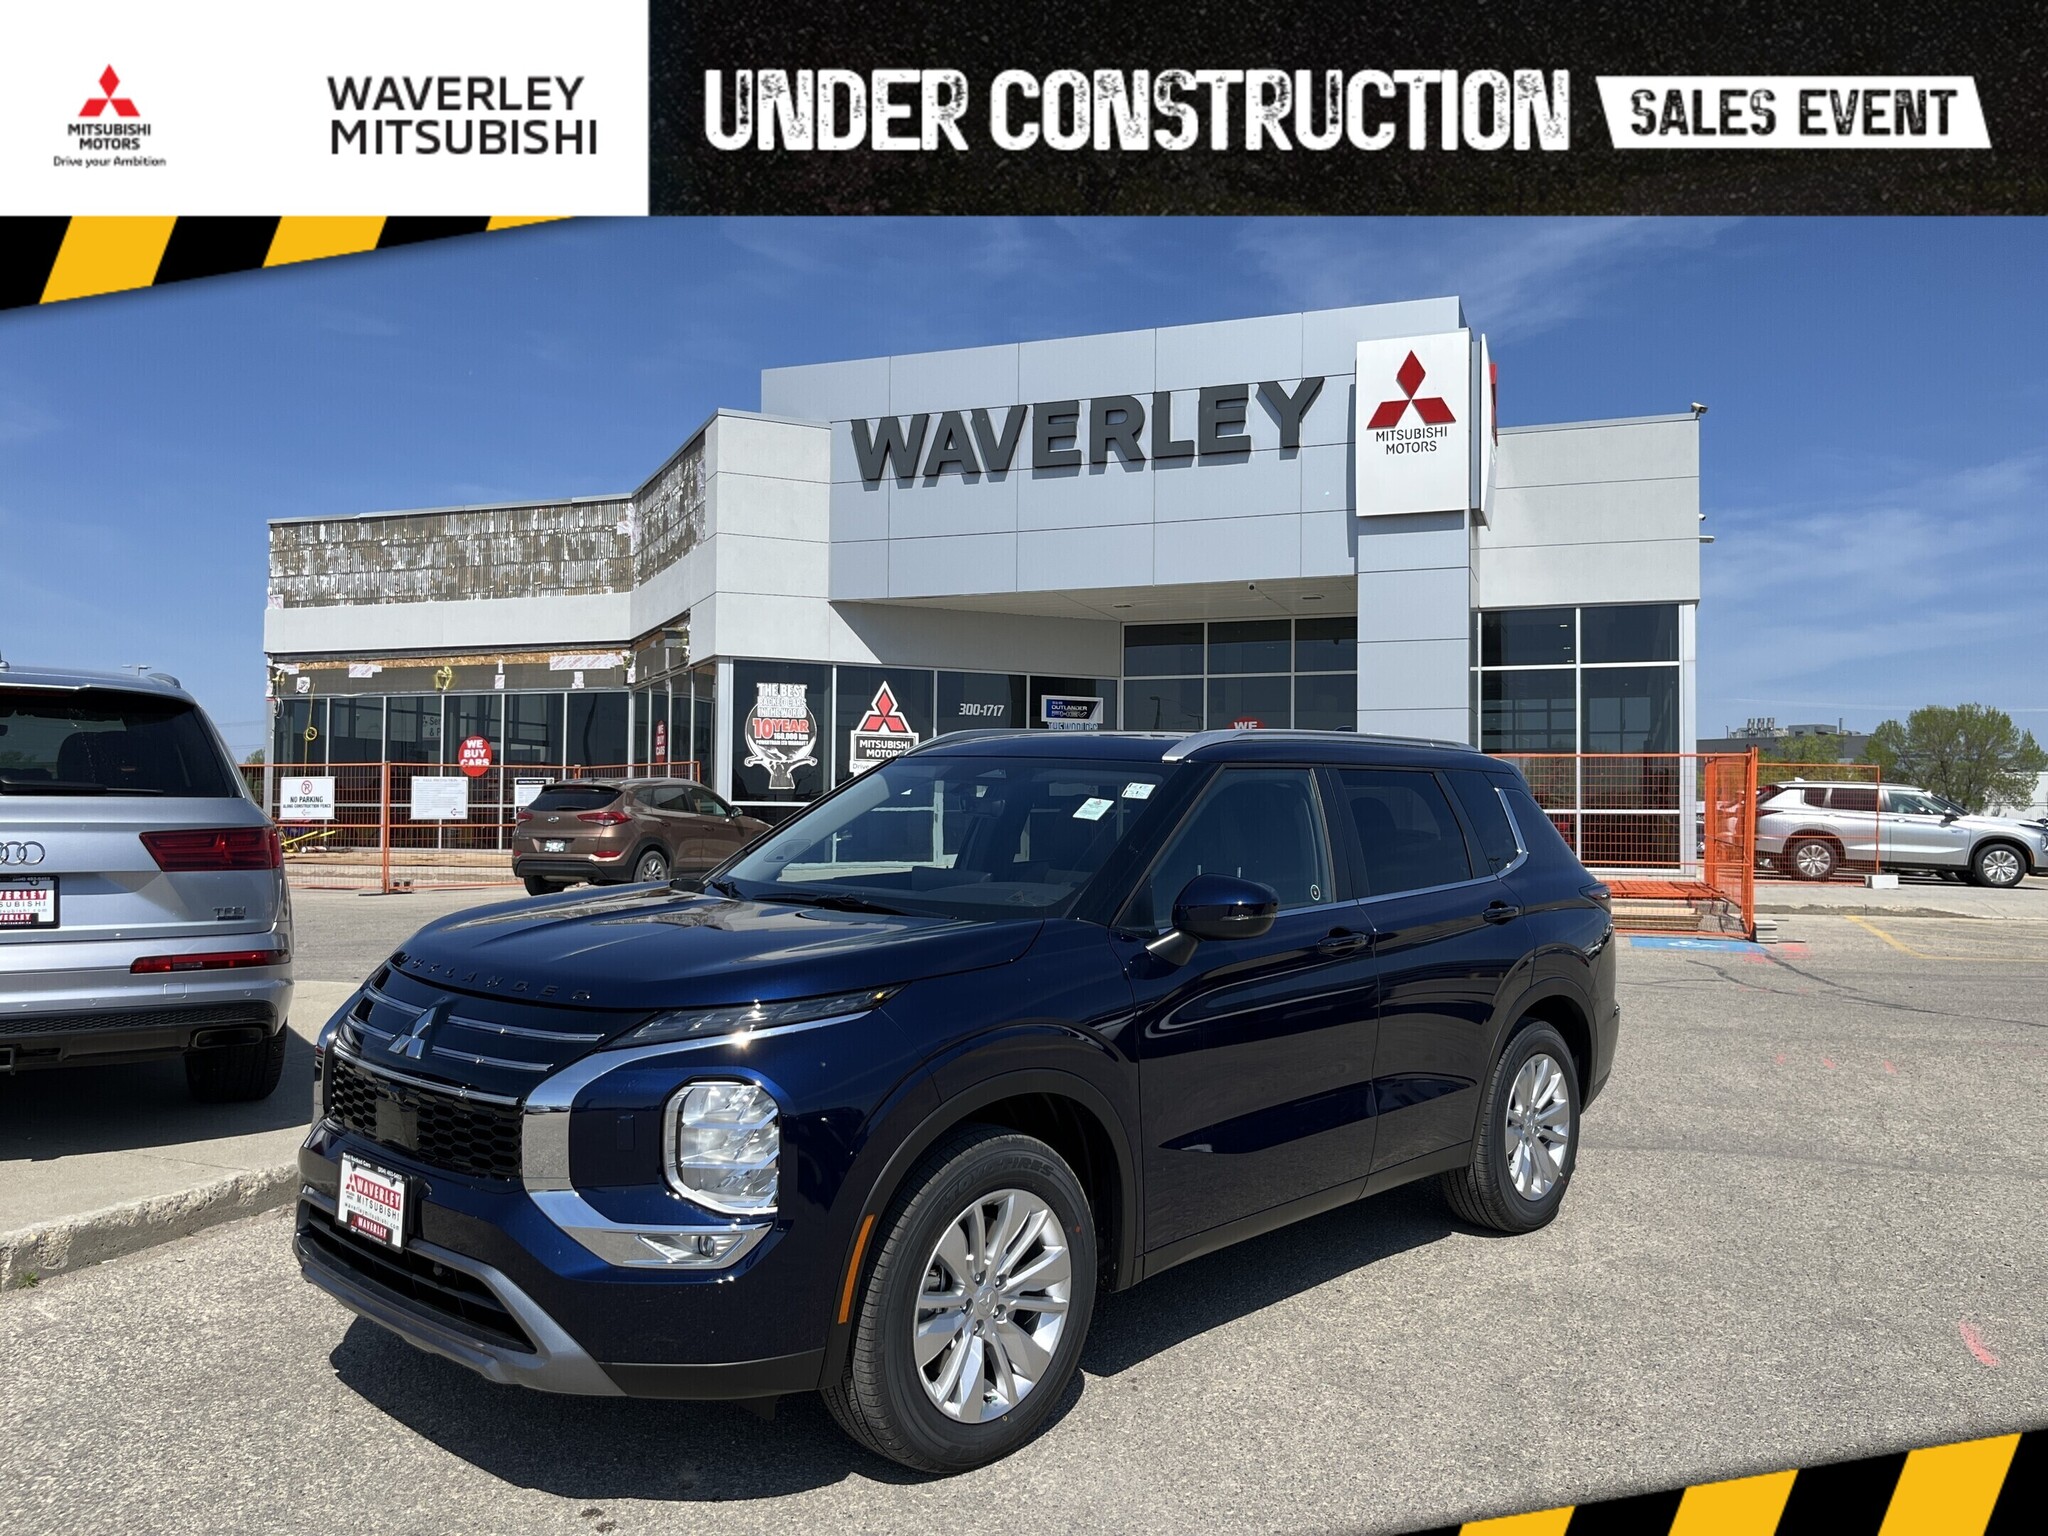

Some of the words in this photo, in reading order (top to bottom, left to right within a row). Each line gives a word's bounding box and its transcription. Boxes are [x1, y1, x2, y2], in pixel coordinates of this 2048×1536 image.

[851, 377, 1326, 482] WAVERLEY
[1375, 426, 1448, 442] MITSUBISHI
[1386, 440, 1437, 455] MOTORS
[756, 683, 779, 697] THE
[779, 683, 808, 698] BEST
[958, 703, 1005, 717] 300-1717
[752, 718, 774, 739] 10
[772, 718, 809, 733] YEAR
[466, 739, 484, 748] WE
[859, 739, 911, 750] MITSUBISHI
[463, 748, 486, 758] BUY
[460, 758, 490, 768] CARS
[299, 795, 324, 803] PARKING
[356, 1176, 401, 1209] WAVERLEY
[356, 1193, 400, 1222] MITSUBISHI
[358, 1216, 388, 1239] WAVERLEY
